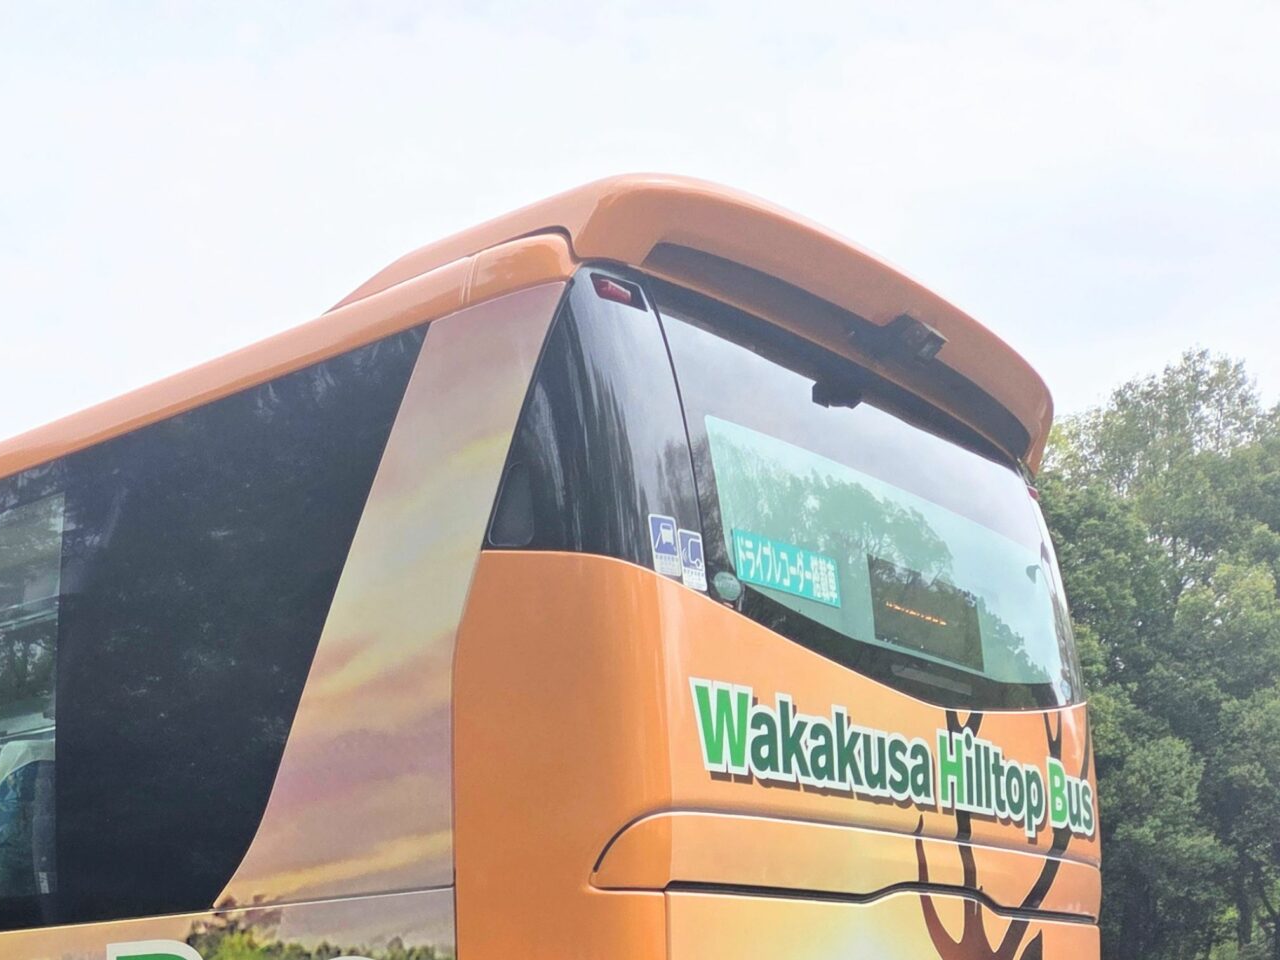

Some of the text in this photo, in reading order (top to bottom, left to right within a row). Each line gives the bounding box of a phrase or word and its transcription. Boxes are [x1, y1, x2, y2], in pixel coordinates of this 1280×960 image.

[691, 680, 1094, 835] Wakakusa Hilltop Bus
